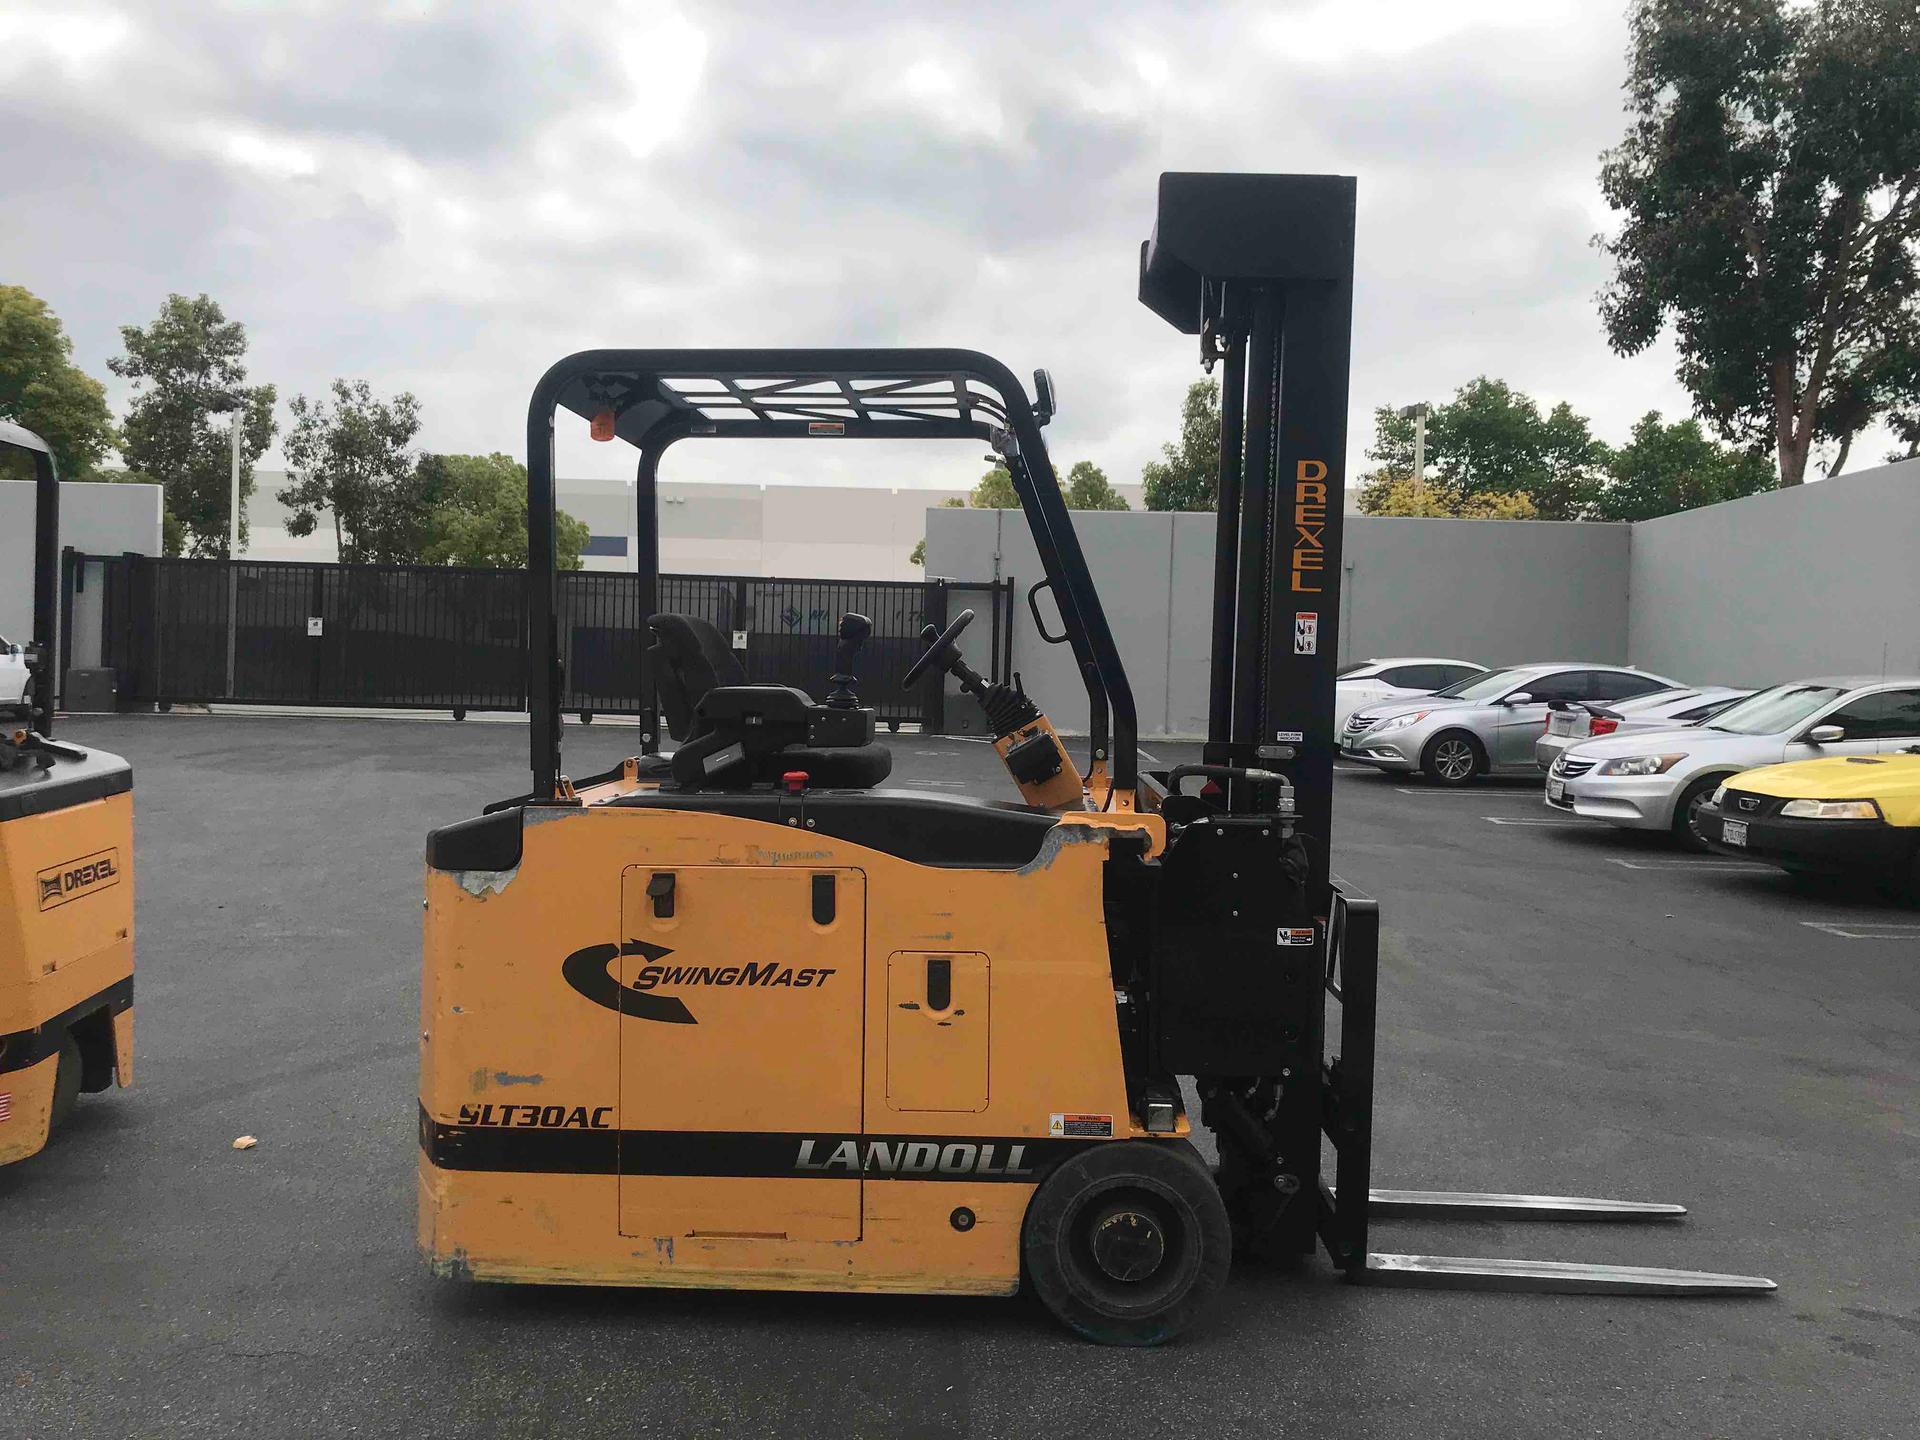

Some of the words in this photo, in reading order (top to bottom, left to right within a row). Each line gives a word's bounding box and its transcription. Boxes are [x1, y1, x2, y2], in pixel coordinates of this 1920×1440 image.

[1291, 460, 1328, 592] DREXEL
[64, 858, 118, 892] DREXEL
[457, 1104, 613, 1128] SLT30AC
[794, 1139, 1033, 1175] LANDOLL
